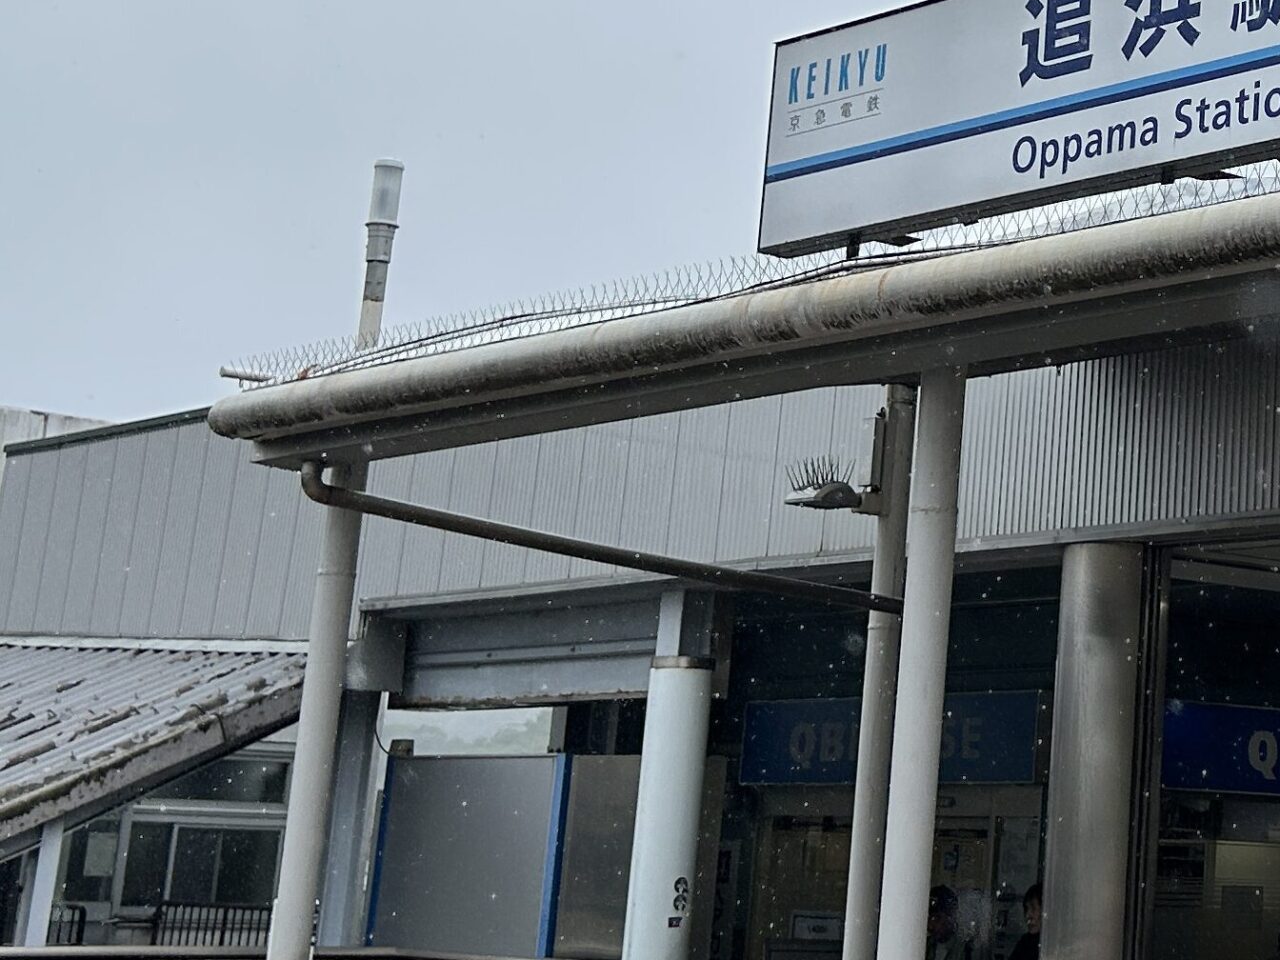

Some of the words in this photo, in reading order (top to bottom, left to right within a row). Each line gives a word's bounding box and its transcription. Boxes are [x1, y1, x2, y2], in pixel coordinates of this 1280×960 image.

[788, 43, 888, 105] KEIKYU
[788, 94, 880, 132] 京急電鉄
[1012, 115, 1159, 179] Oppama
